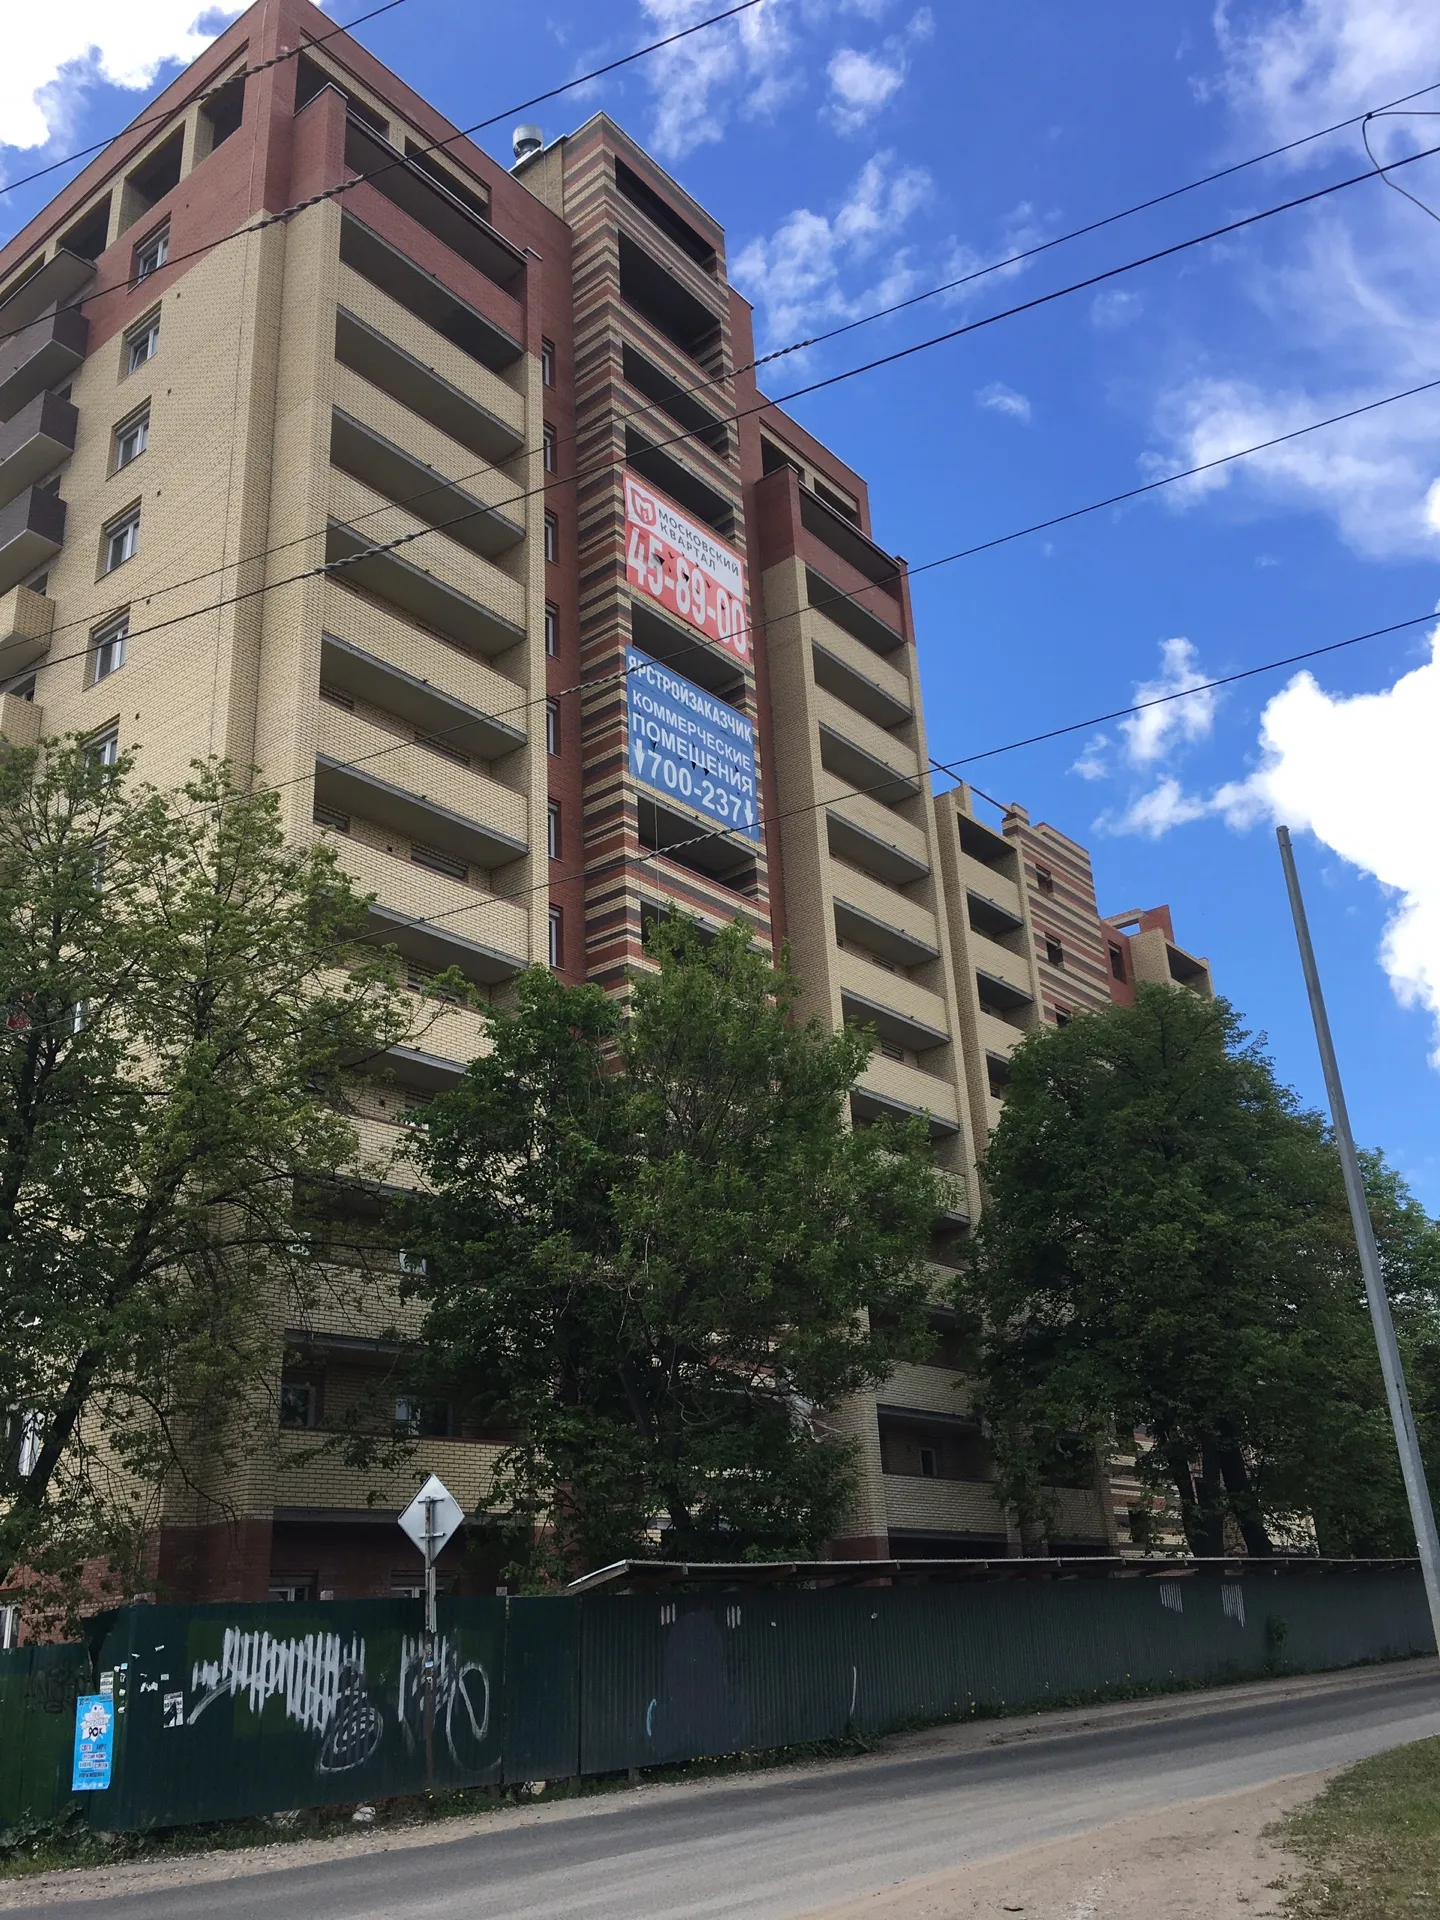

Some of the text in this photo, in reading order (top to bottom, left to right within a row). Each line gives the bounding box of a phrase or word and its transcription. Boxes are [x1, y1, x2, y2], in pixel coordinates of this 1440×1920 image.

[658, 508, 740, 577] МОСКОВСКИЙ
[660, 523, 717, 571] КВАРТАЛ
[627, 527, 747, 655] 45-89-00
[628, 655, 752, 744] ЯРСТРОЙЗАКАЗЧИК
[632, 689, 752, 772] КОММЕРЧЕСКИЕ
[633, 714, 753, 797] ПОМЕЩЕНИЯ
[647, 749, 742, 823] 700-237
